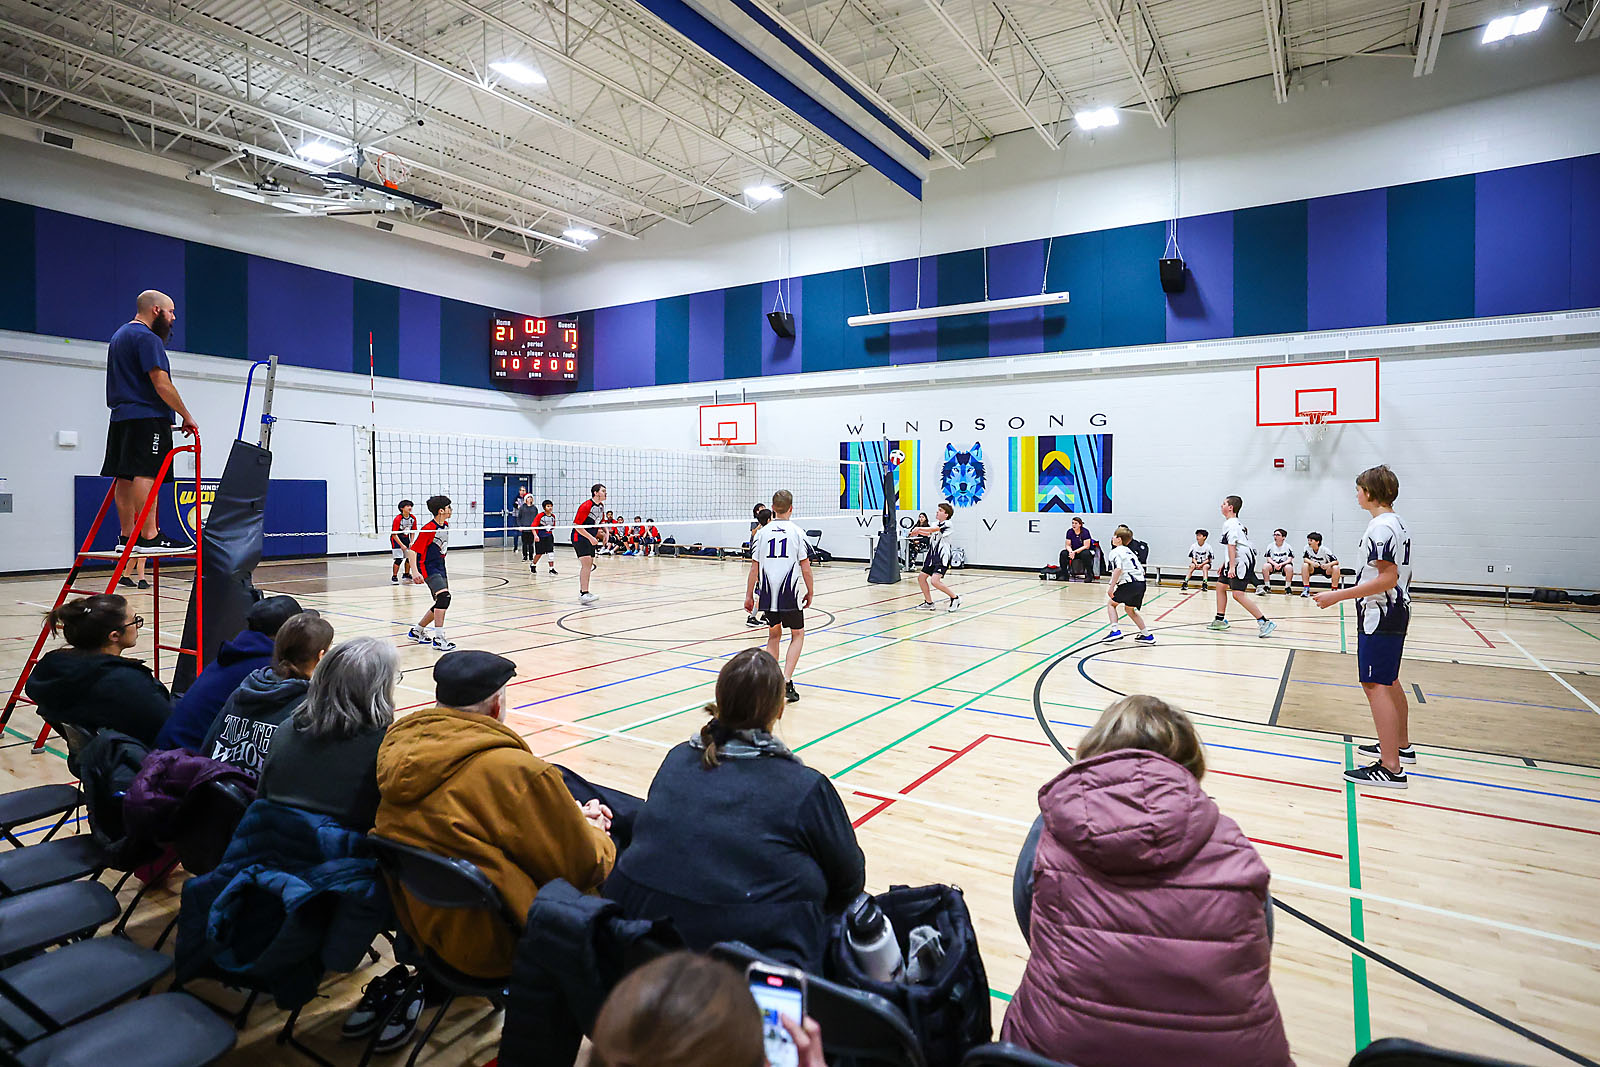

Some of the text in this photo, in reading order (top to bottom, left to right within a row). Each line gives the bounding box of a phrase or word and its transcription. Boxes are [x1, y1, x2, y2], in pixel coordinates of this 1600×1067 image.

[496, 327, 514, 341] 21
[525, 320, 546, 334] 0.0
[564, 329, 577, 343] 17
[533, 359, 541, 370] 2
[566, 360, 574, 371] 0
[846, 413, 1108, 435] WINDSONG
[766, 537, 789, 558] 11
[252, 721, 278, 754] TH
